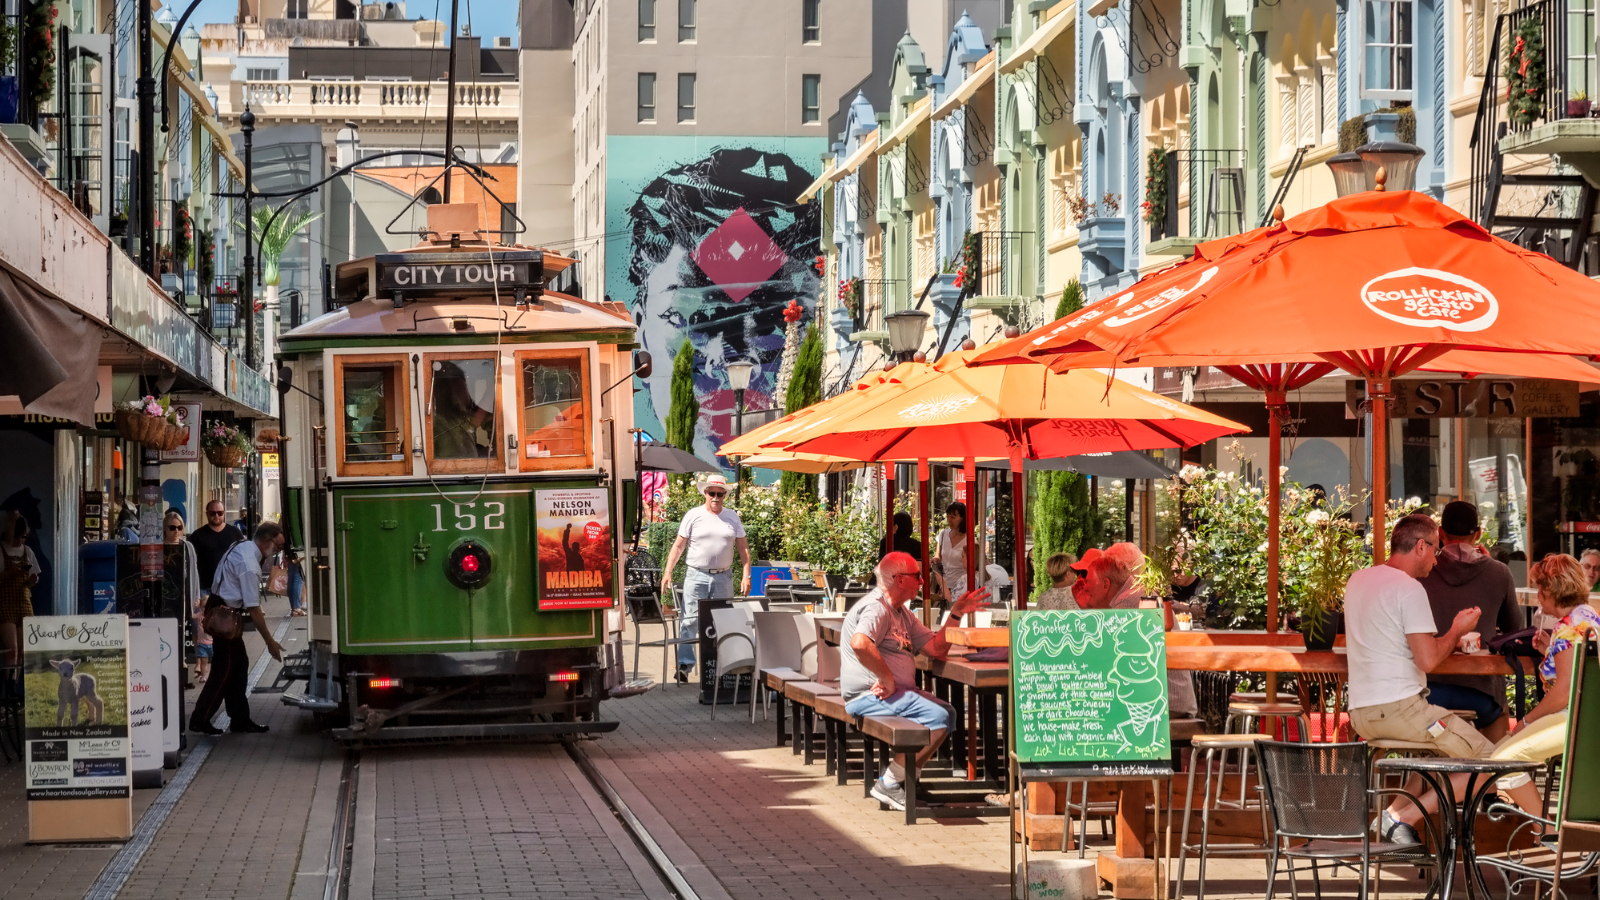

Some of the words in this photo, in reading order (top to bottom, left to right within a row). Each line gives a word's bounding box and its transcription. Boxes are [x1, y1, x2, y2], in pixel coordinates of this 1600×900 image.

[394, 265, 447, 285] CITY
[451, 263, 515, 283] TOUR
[1521, 380, 1549, 391] FOOD
[1522, 392, 1562, 403] COFFEE
[1522, 405, 1570, 415] GALLERY
[431, 501, 505, 532] 152
[549, 508, 596, 517] MANDELA
[546, 570, 603, 589] MADIBA
[78, 621, 109, 644] Soul
[1032, 619, 1072, 636] Banoffee
[1074, 620, 1087, 633] Pie
[1020, 661, 1036, 672] Real
[1074, 671, 1103, 680] rumbled
[1060, 690, 1068, 699] of
[1070, 690, 1088, 698] thick
[1089, 689, 1115, 698] caramel
[1037, 711, 1044, 719] of
[1046, 710, 1062, 719] dark
[1083, 718, 1104, 730] fresh
[86, 728, 111, 736] Zealand
[1024, 733, 1041, 743] each
[1043, 732, 1056, 747] day
[1058, 731, 1073, 741] with
[1076, 733, 1105, 746] organic
[1034, 744, 1052, 757] Lick
[1059, 743, 1079, 757] Lick
[37, 764, 71, 772] BOWRON
